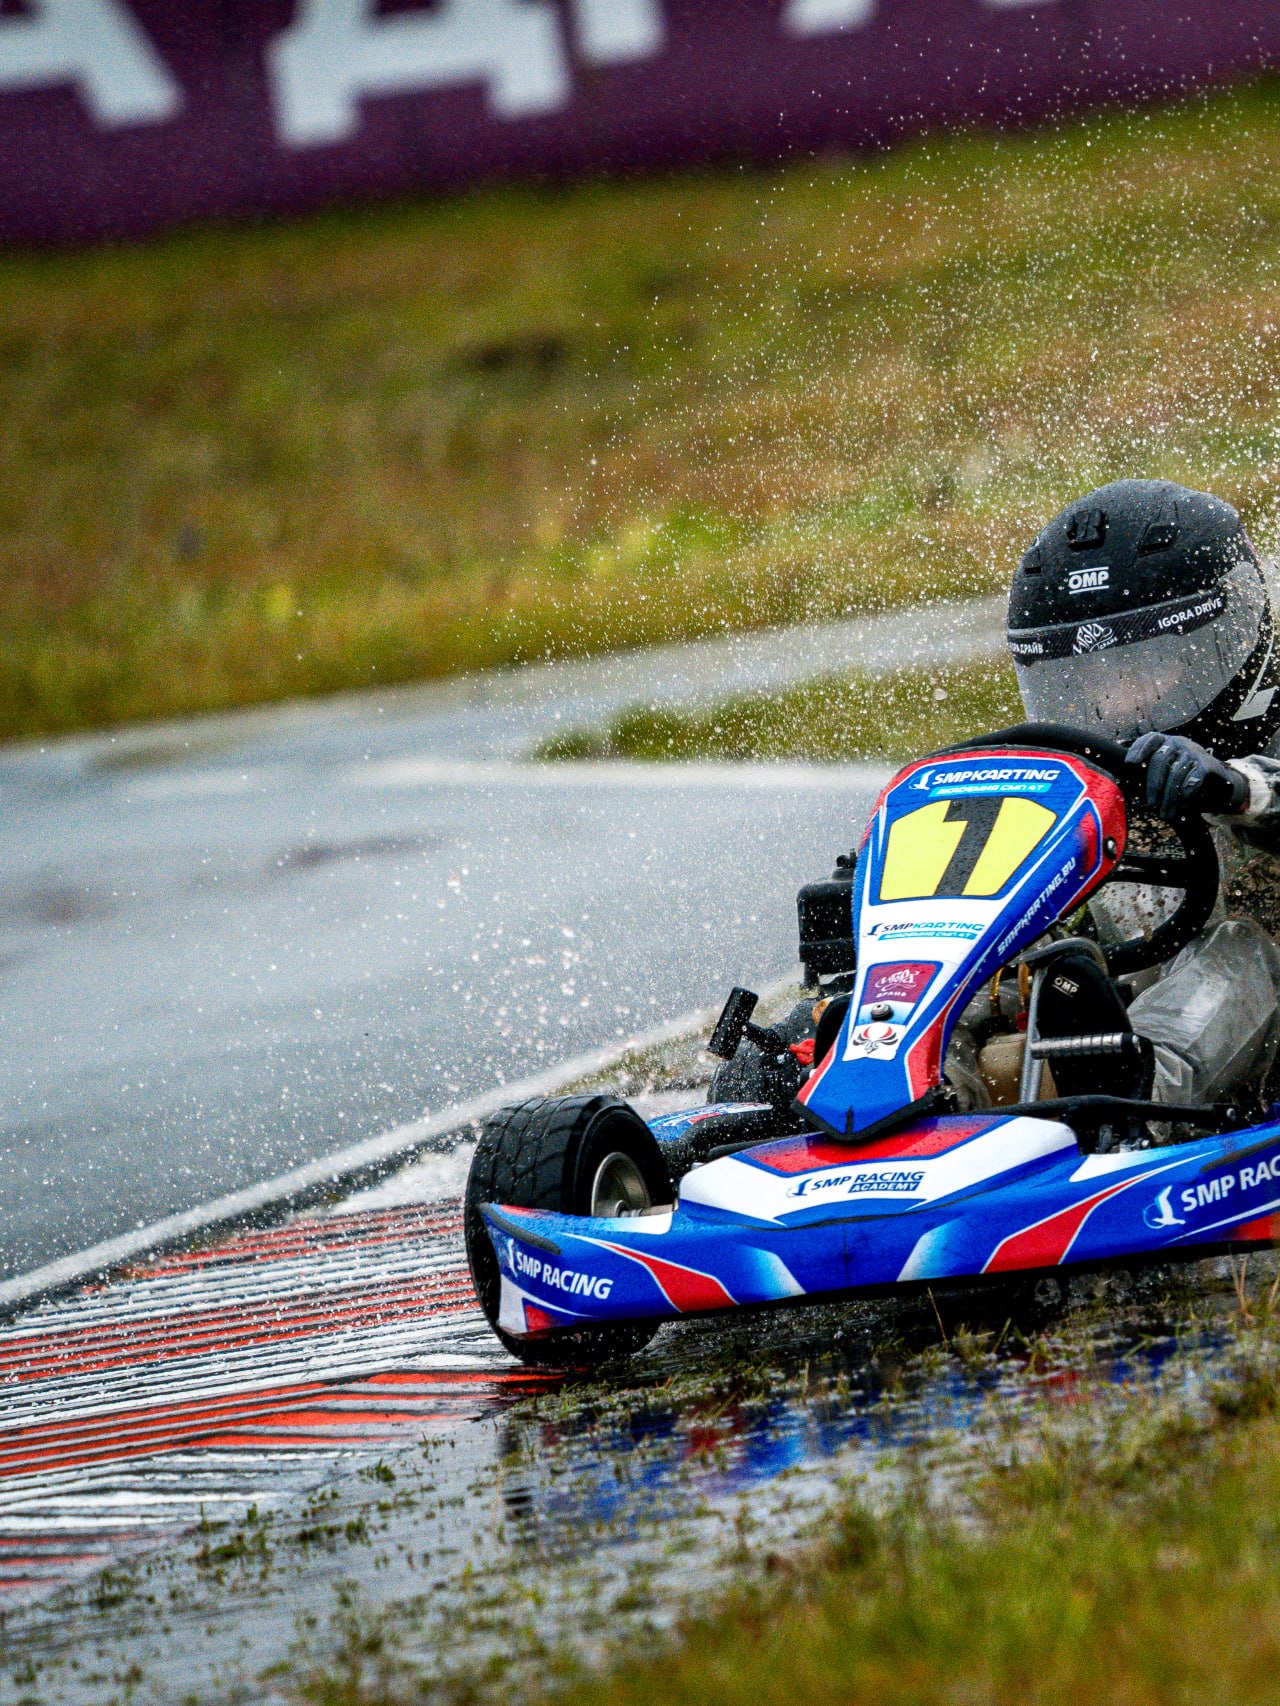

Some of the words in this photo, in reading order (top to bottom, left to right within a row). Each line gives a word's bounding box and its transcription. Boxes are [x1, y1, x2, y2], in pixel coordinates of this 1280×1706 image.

[1068, 570, 1109, 590] OMP
[1158, 609, 1195, 629] IGORA
[1194, 598, 1223, 616] DRIVE
[882, 921, 985, 932] SMPKARTING
[1054, 976, 1078, 994] OMP
[811, 1176, 852, 1191] SMP
[854, 1171, 926, 1183] RACING
[850, 1182, 918, 1193] ACADEMY
[1181, 1174, 1236, 1212] SMP
[516, 1251, 542, 1278] SMP
[542, 1263, 614, 1300] RACING
